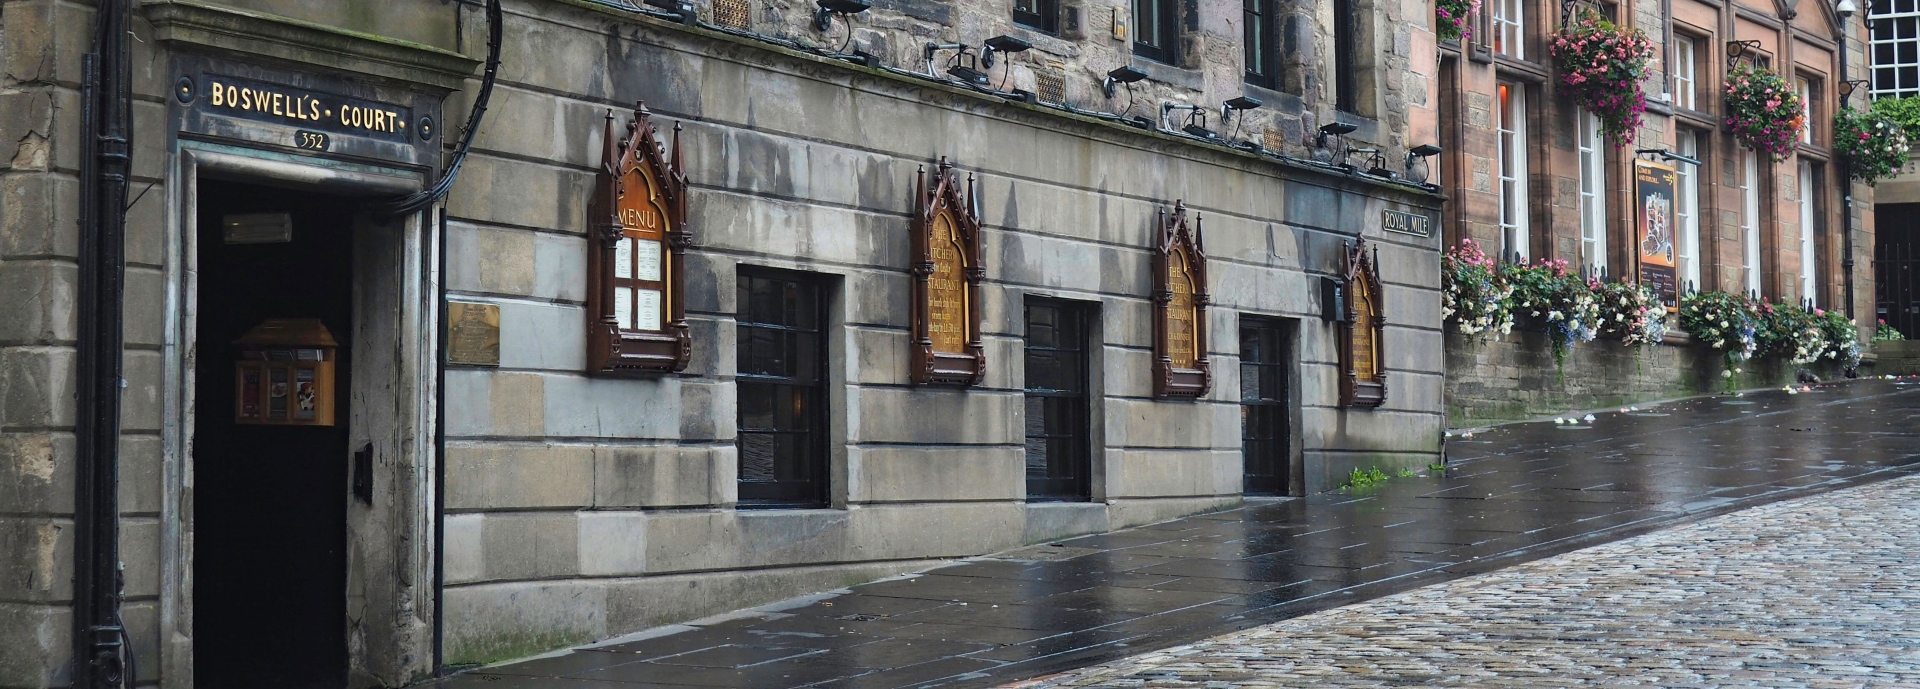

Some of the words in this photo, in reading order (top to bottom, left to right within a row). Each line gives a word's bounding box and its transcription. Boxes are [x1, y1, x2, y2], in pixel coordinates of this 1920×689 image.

[212, 82, 320, 121] BOSWELL'S
[341, 105, 397, 132] COURT
[301, 132, 323, 149] 352
[618, 207, 656, 229] MENU
[1385, 211, 1408, 231] ROYAL
[1411, 216, 1428, 234] MILE
[934, 229, 947, 240] THE
[1169, 266, 1181, 278] THE
[928, 277, 960, 291] STAURANT
[1166, 308, 1193, 322] STAURANT
